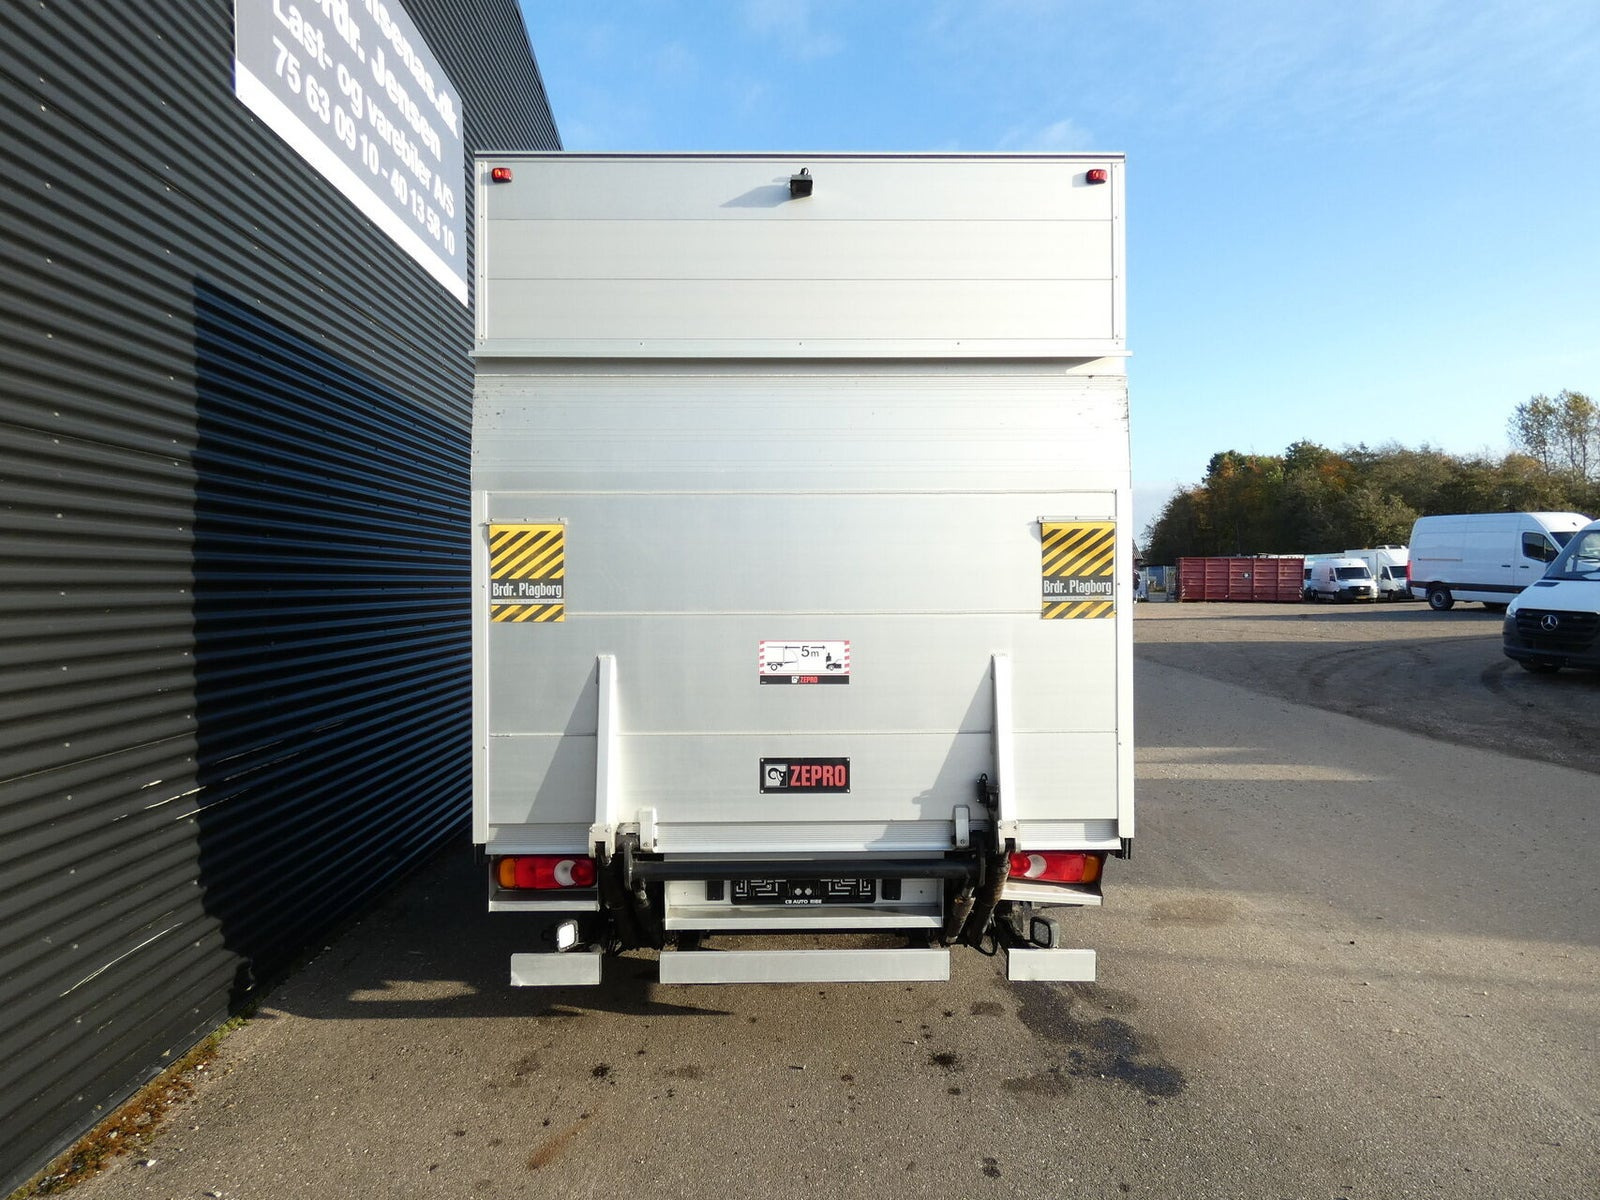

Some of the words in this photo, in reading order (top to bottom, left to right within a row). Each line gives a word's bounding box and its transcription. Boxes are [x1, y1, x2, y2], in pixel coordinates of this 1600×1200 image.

[314, 0, 366, 64] rdr.
[371, 45, 441, 163] Jensen
[273, 0, 333, 71] Last-
[337, 62, 363, 119] og
[366, 94, 432, 191] varebiler
[433, 174, 455, 218] A/S
[272, 34, 301, 94] 75
[305, 74, 331, 125] 63
[334, 104, 356, 151] 09
[359, 133, 379, 175] 10
[390, 168, 408, 206] 40
[409, 188, 425, 224] 13
[426, 205, 441, 241] 58
[442, 224, 455, 256] 10
[492, 582, 517, 596] Brdr.
[518, 582, 562, 599] Plagborg
[1043, 580, 1067, 594] Brdr.
[1069, 580, 1112, 595] Plagborg
[799, 676, 819, 684] ZEPRO
[790, 765, 846, 787] ZEPRO
